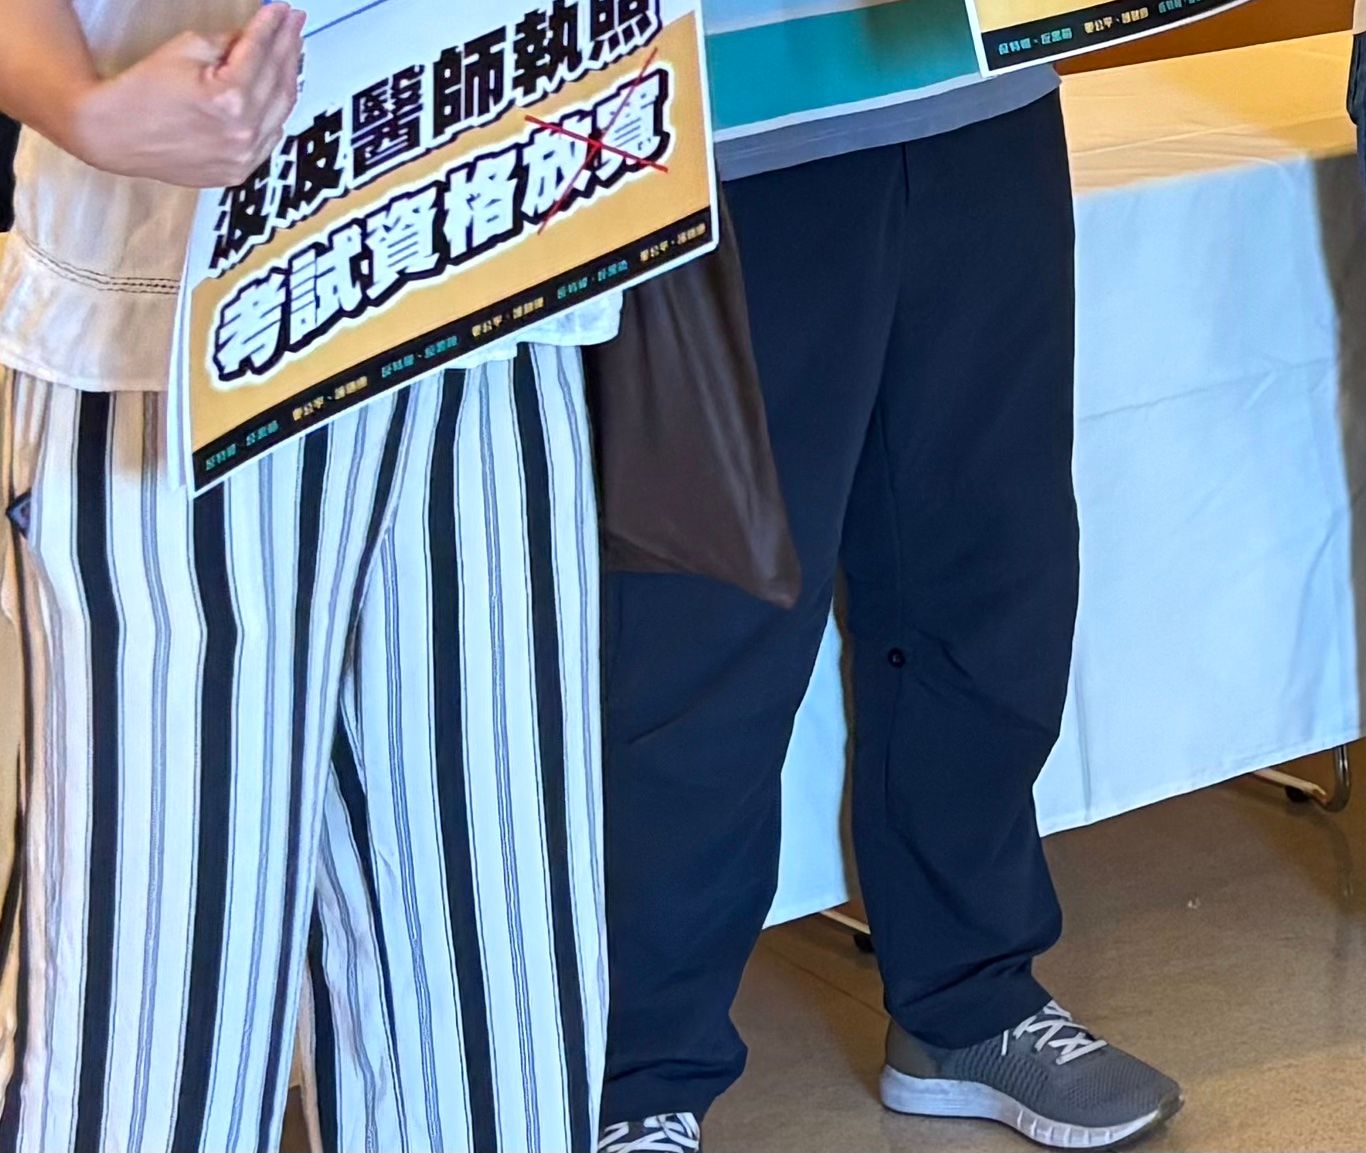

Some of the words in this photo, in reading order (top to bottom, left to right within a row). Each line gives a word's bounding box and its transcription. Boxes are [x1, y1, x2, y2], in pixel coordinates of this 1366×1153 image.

[213, 72, 667, 378] 考試資格放寬
